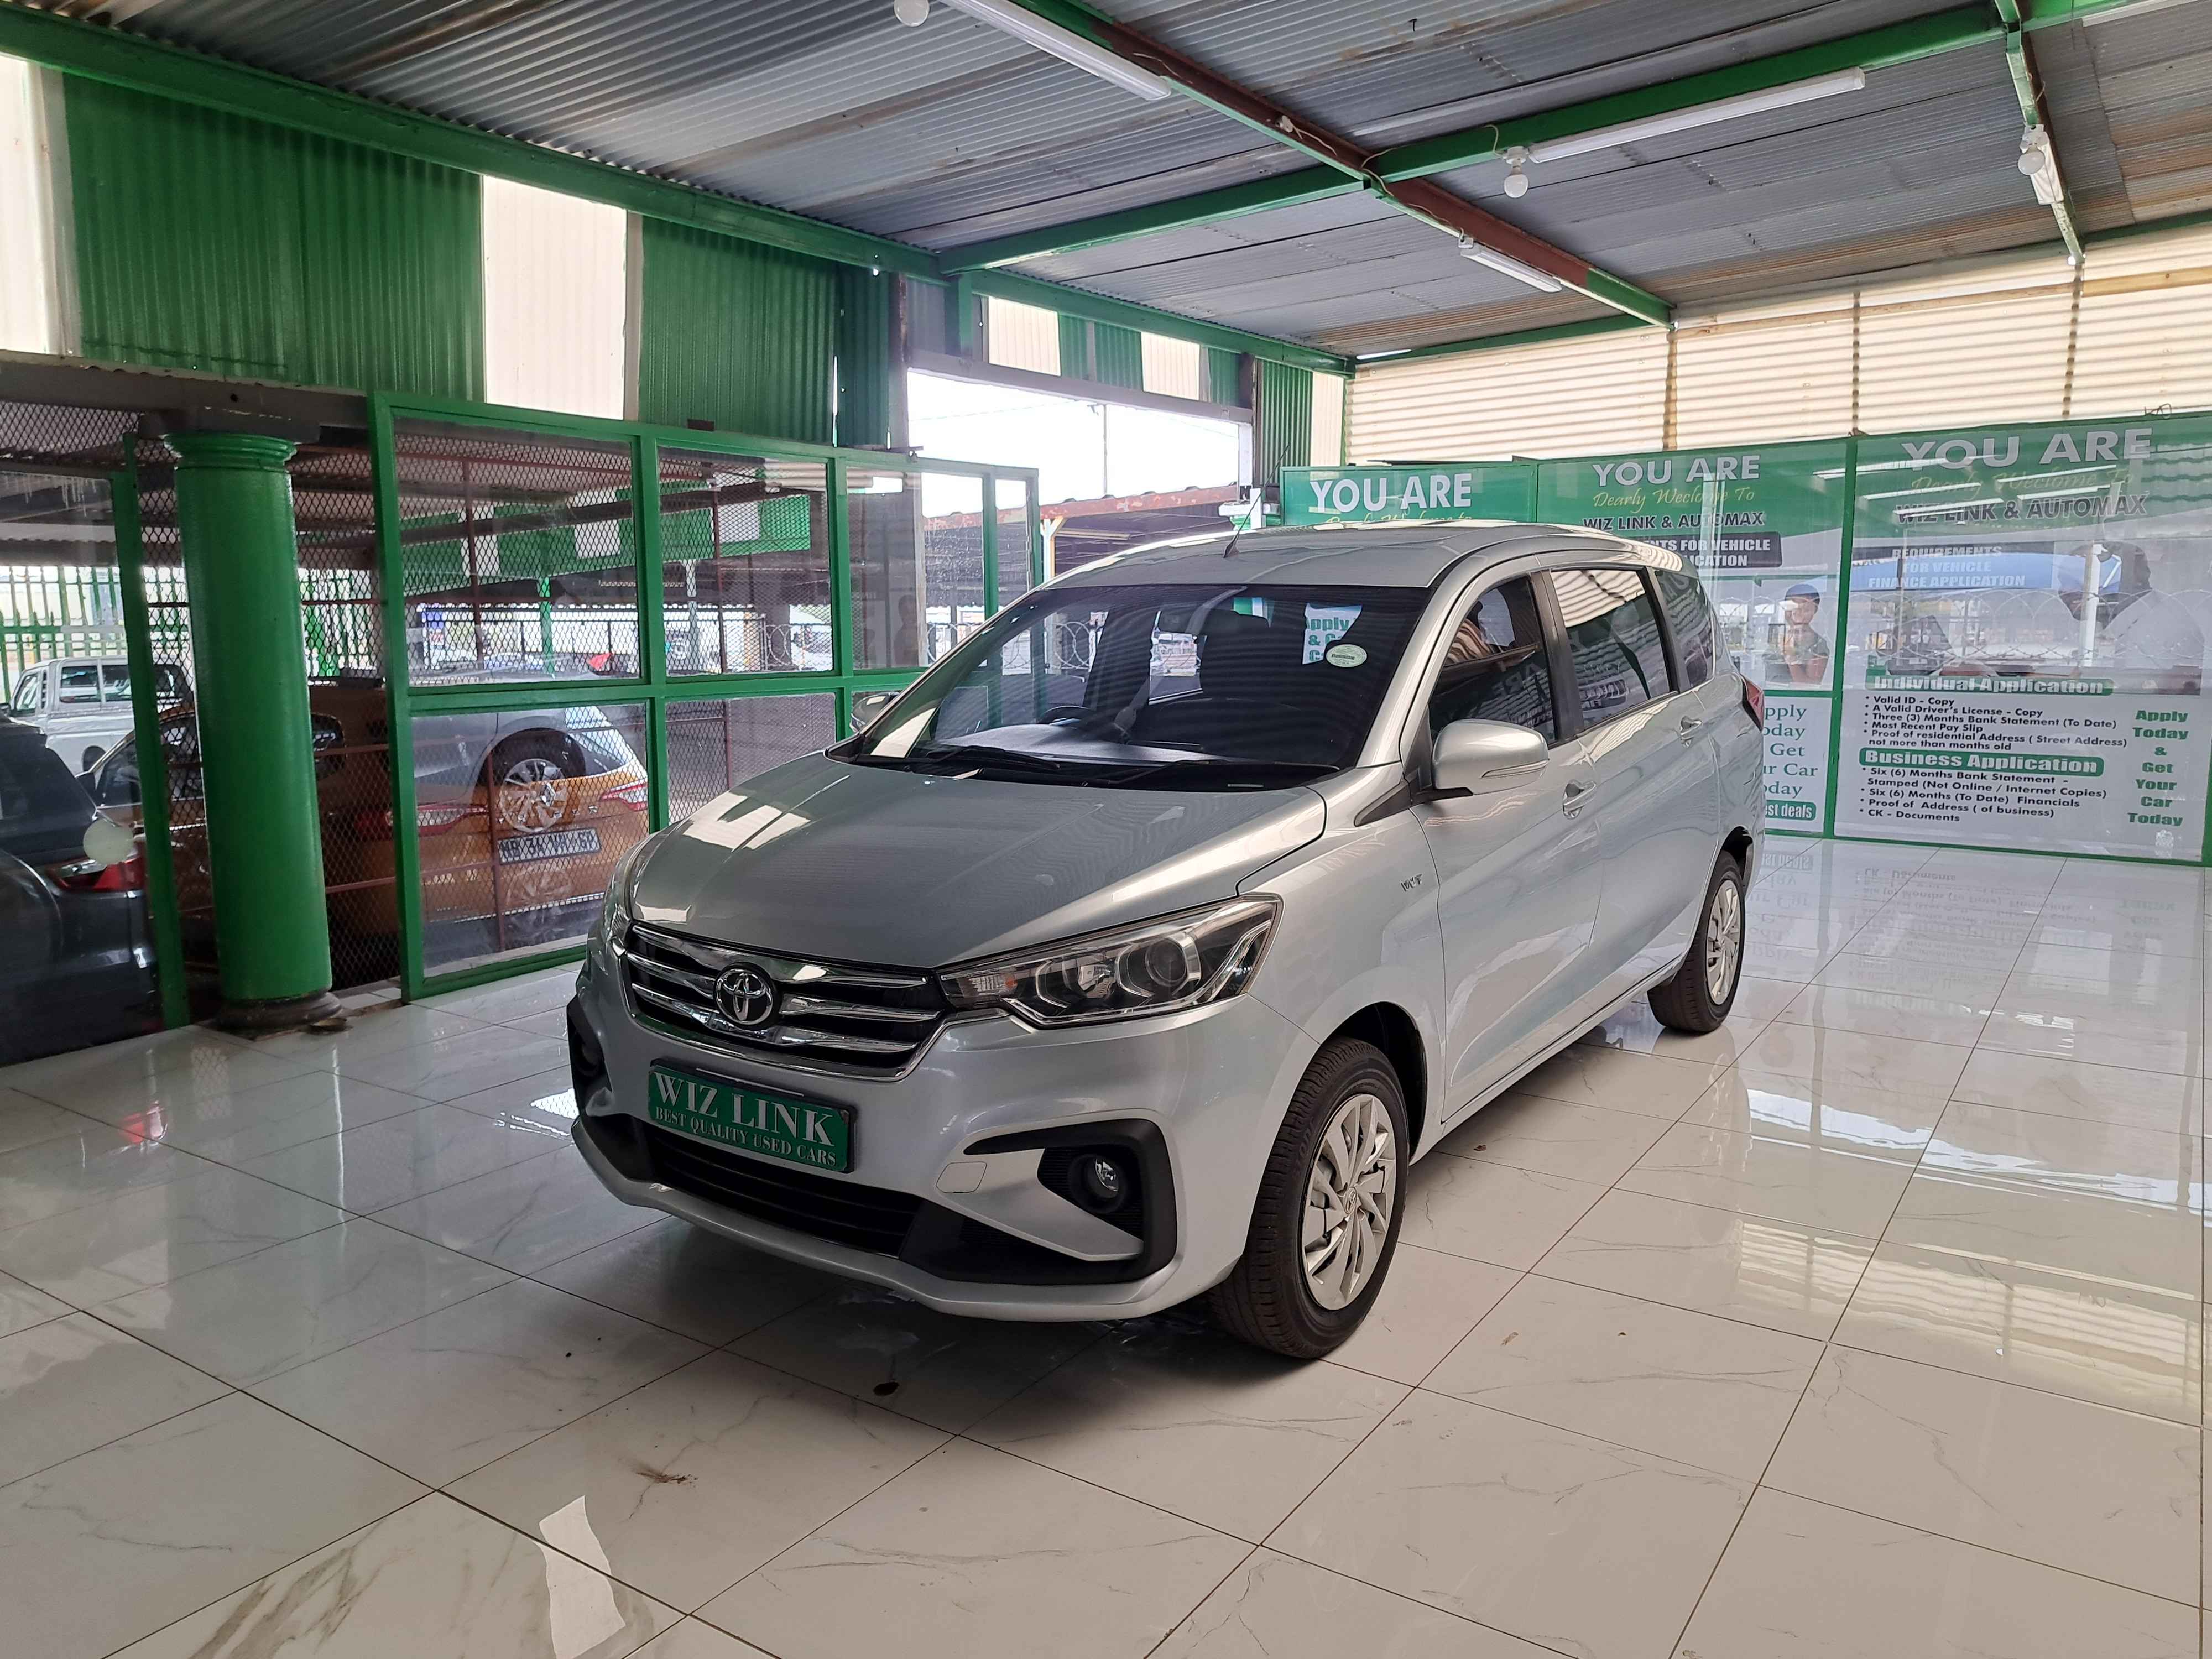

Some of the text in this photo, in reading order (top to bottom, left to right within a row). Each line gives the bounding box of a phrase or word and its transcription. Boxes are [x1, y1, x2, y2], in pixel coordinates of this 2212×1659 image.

[1901, 428, 2152, 471] YOU ARE
[1593, 455, 1761, 487] YOU ARE
[1310, 473, 1472, 513] YOU ARE
[1593, 487, 1646, 514] Dearly
[1735, 487, 1755, 501] To
[2003, 500, 2020, 520] &
[2026, 491, 2150, 519] AUTOMAX
[1582, 517, 1614, 531] WIZ
[1618, 515, 1658, 530] LINK
[1661, 515, 1673, 529] &
[1681, 539, 1708, 551] FOR
[1711, 539, 1771, 551] VEHICLE
[1903, 561, 1991, 573] FOR VEHICLE
[1869, 575, 2026, 588] FINANCE APPLICATION
[1308, 635, 1321, 646] &
[1874, 676, 2103, 693] Individual Application
[1928, 697, 1954, 706] Copy
[1765, 704, 1807, 721] pply
[2015, 708, 2043, 718] Copy
[2135, 710, 2188, 723] Apply
[1906, 714, 1920, 722] (3)
[1968, 716, 1997, 724] Bank
[2001, 717, 2059, 726] Statement
[2063, 718, 2080, 728] (To
[2084, 719, 2117, 729] Date)
[1940, 723, 1959, 732] Pay
[1963, 724, 1983, 733] Slip
[1764, 723, 1805, 740] oday
[1872, 729, 1900, 738] Proof
[1917, 732, 1975, 740] residential
[1979, 733, 2025, 742] Address
[2037, 735, 2071, 744] Street
[2074, 737, 2127, 747] Address)
[2132, 727, 2189, 740] Today
[1770, 743, 1805, 757] Get
[1949, 742, 1990, 750] months
[2154, 747, 2167, 755] &
[1865, 750, 2098, 773] Business Application
[2142, 762, 2173, 773] Get
[1783, 763, 1819, 776] Car
[1891, 769, 1906, 778] (6)
[1910, 769, 1953, 779] Months
[1957, 772, 1988, 780] Bank
[1992, 773, 2055, 784] Statement
[1867, 778, 1919, 788] Stamped
[1922, 780, 1948, 790] (Not
[1952, 782, 1992, 791] Online
[2006, 785, 2056, 795] Internet
[2060, 787, 2107, 799] Copies)
[2136, 779, 2177, 790] Your
[1889, 790, 1905, 799] (6)
[1908, 791, 1951, 800] Months
[1955, 793, 1972, 802] (To
[1976, 794, 2009, 805] Date)
[2017, 796, 2080, 807] Financials
[2141, 796, 2173, 807] Car
[1781, 804, 1812, 818] deals
[1869, 799, 1899, 807] Proof
[1921, 801, 1969, 811] Address
[1997, 806, 2054, 818] business)
[1896, 811, 1960, 822] Documents
[2127, 813, 2183, 826] Today
[655, 1072, 835, 1147] WIZ LINK
[656, 1107, 836, 1167] BEST QUALITY USED CARS
